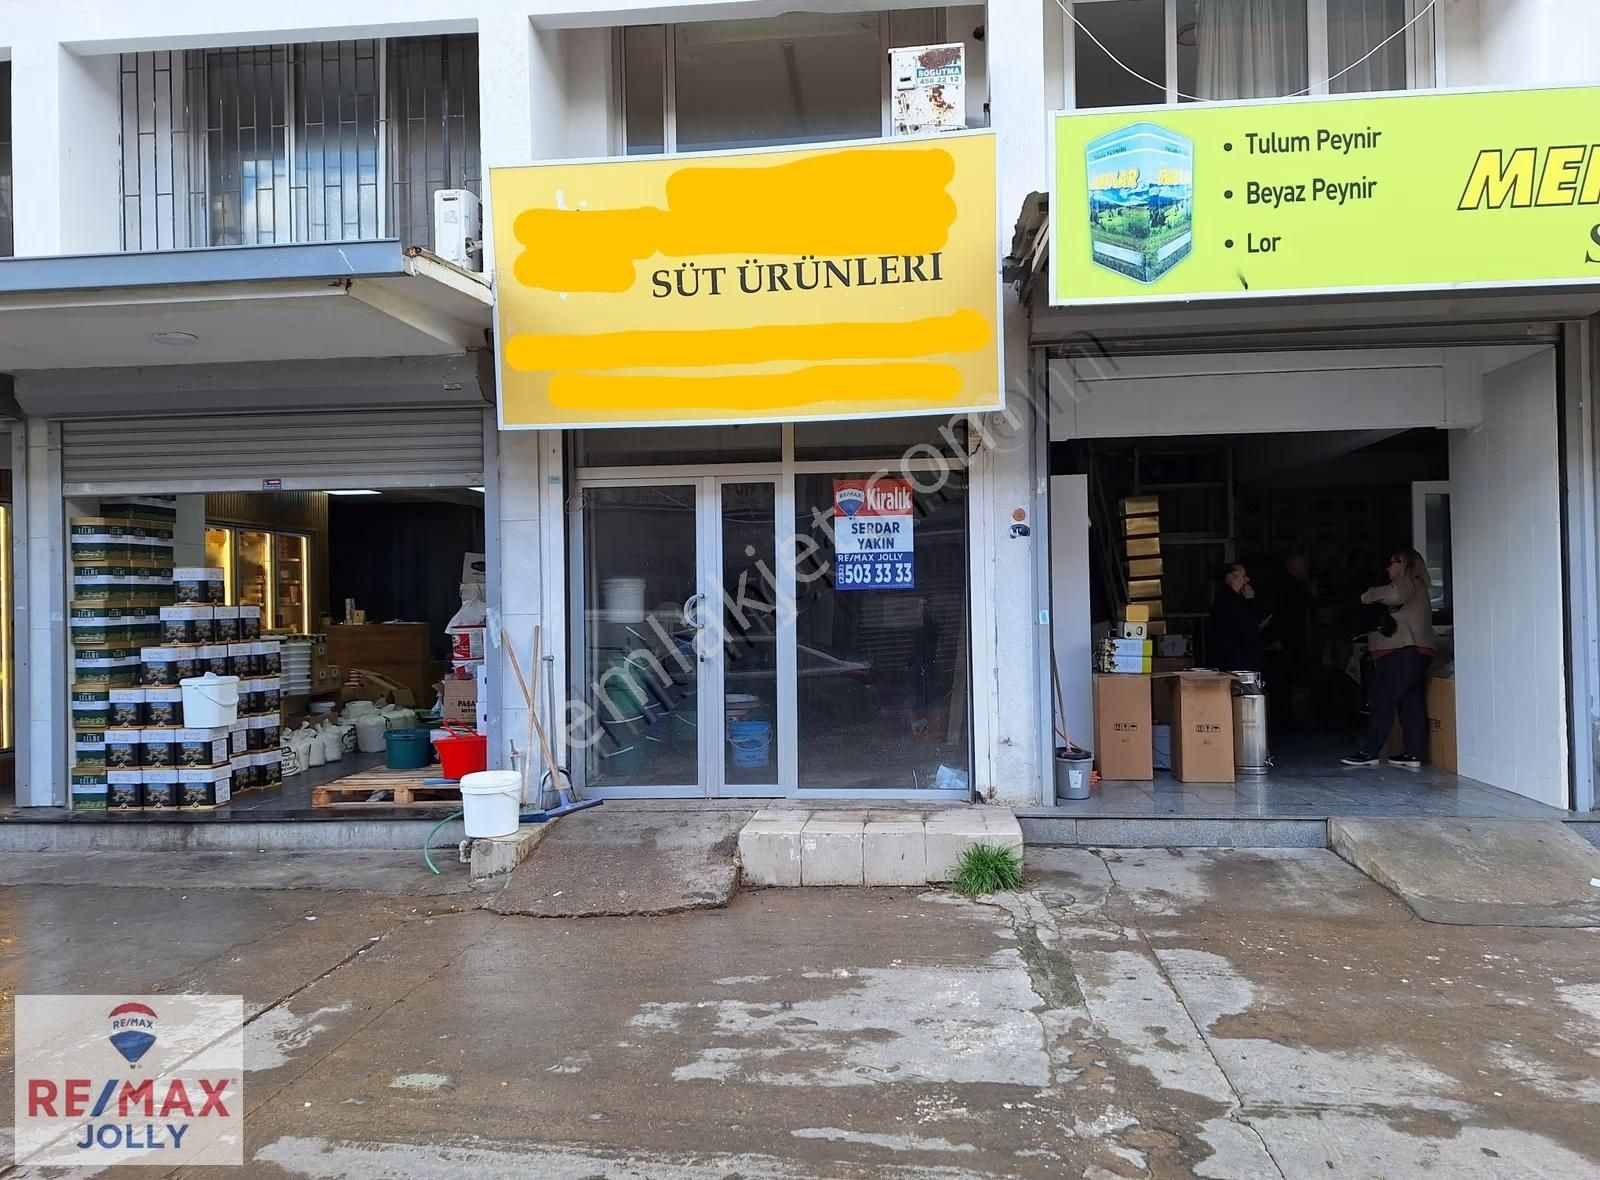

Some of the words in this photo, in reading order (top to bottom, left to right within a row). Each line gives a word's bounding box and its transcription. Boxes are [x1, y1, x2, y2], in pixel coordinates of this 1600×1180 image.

[1245, 132, 1310, 154] Tulum
[1317, 126, 1382, 155] Peynir
[1247, 181, 1306, 209] Beyaz
[1312, 176, 1378, 206] Peynir
[1247, 232, 1282, 253] Lor
[651, 261, 726, 298] SÜT
[866, 486, 912, 511] Kiralık
[851, 521, 900, 534] SERDAR
[857, 538, 895, 549] YAKIN
[838, 554, 874, 562] RE/MAX
[878, 553, 903, 561] JOLLY
[845, 563, 871, 584] 503
[875, 563, 892, 583] 33
[895, 563, 912, 583] 33
